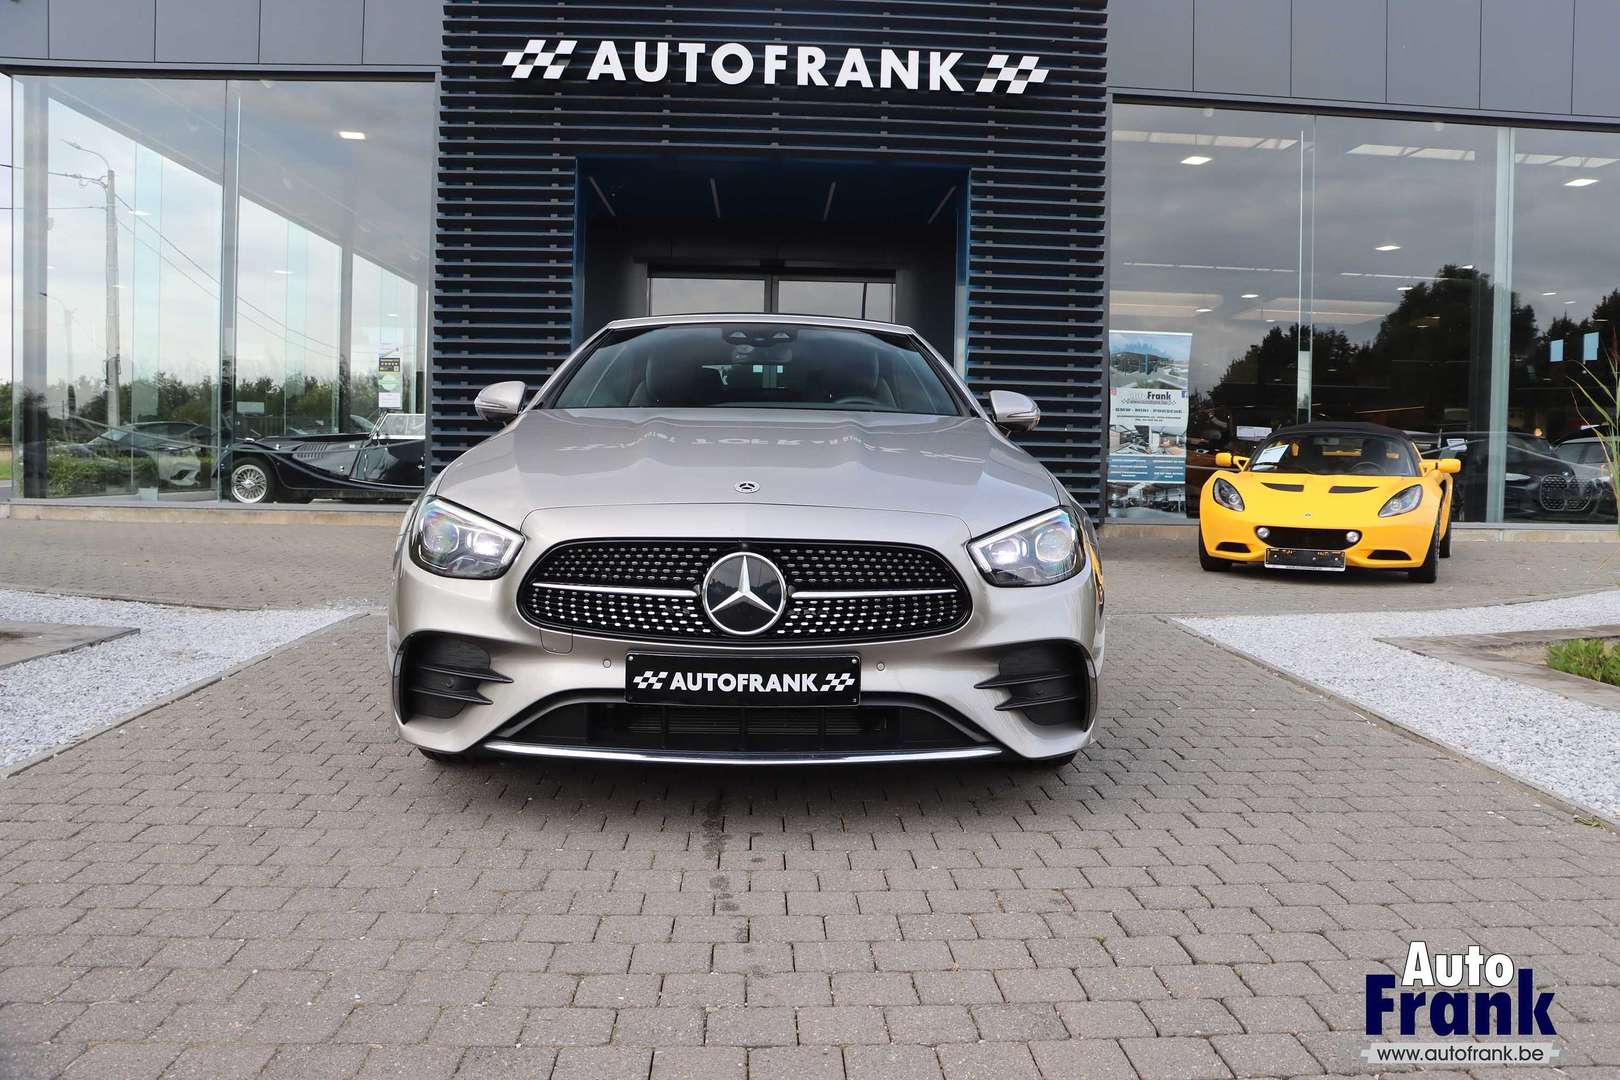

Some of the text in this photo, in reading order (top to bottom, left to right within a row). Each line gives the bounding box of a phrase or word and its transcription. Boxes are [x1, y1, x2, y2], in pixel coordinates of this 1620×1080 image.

[587, 40, 964, 92] AUTOFRANK
[1147, 391, 1172, 401] Frank
[669, 671, 819, 693] AUTOFRANK
